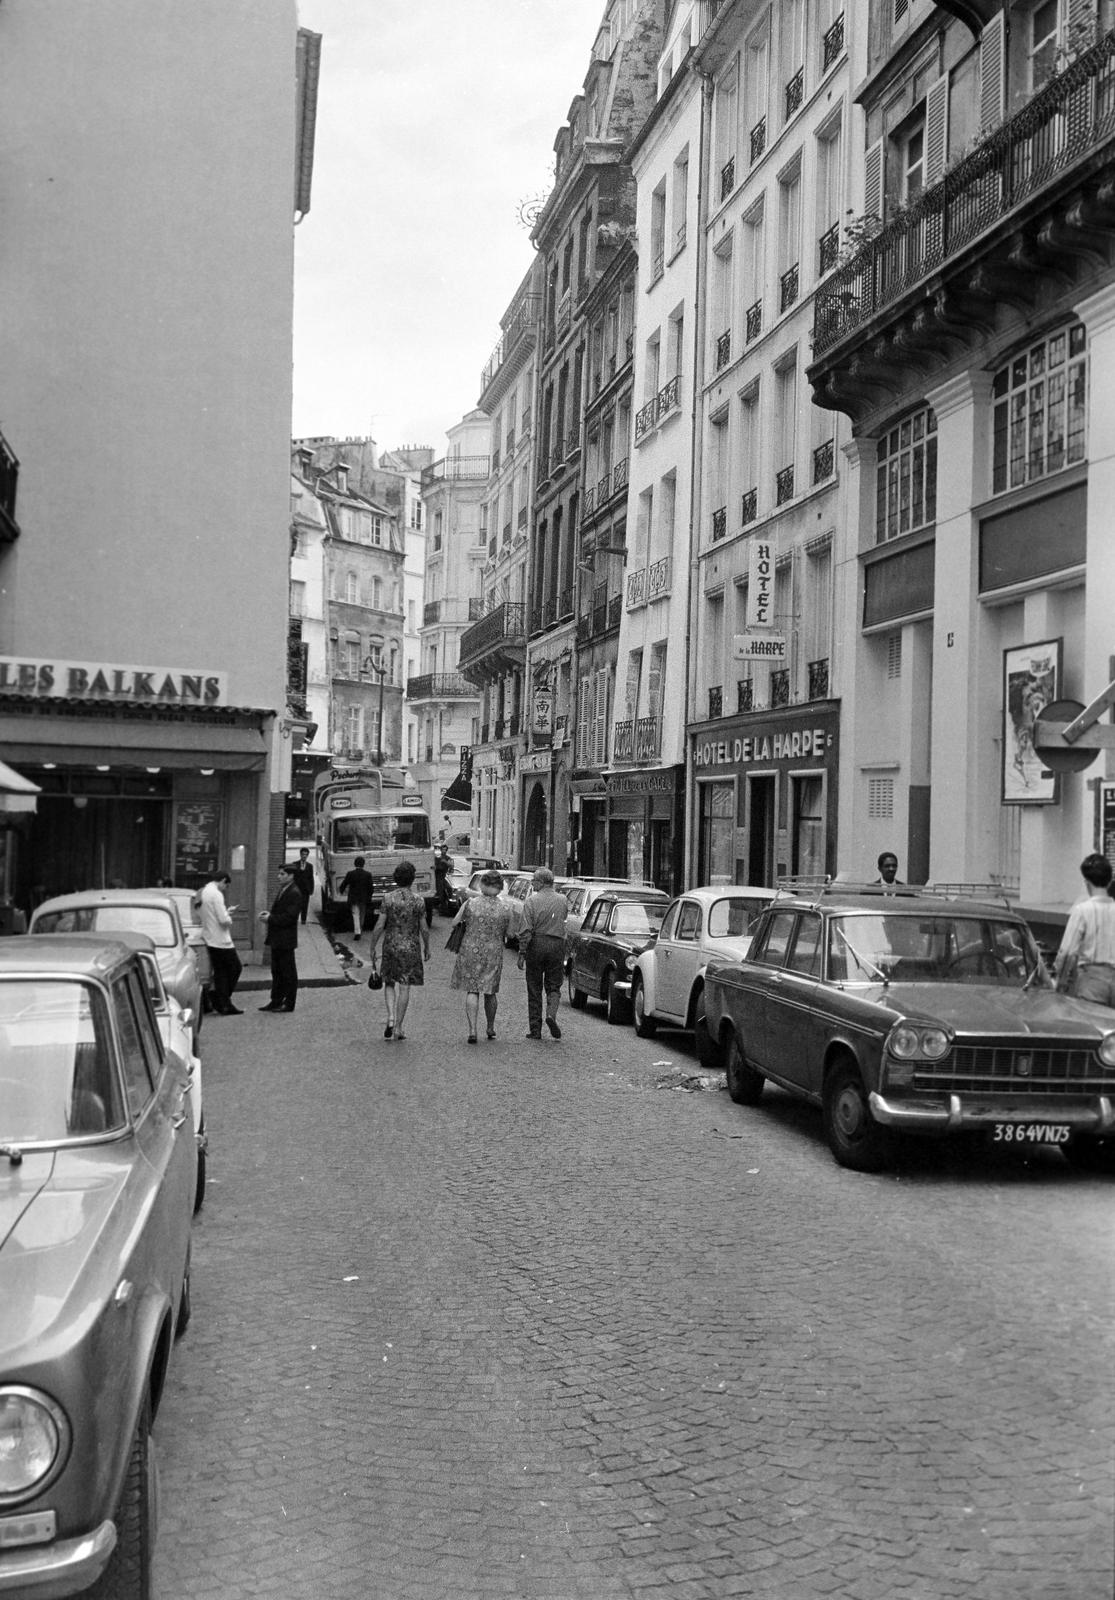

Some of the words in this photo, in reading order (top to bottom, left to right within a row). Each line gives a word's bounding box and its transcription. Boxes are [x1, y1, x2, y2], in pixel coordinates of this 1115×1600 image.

[756, 544, 771, 623] HOTEL
[750, 640, 785, 656] HARPE
[0, 662, 54, 689] LES
[68, 667, 221, 700] BALKANS
[535, 700, 550, 730] 南華
[696, 741, 733, 766] HOTEL
[734, 737, 752, 763] DE
[753, 736, 772, 761] LA
[773, 729, 825, 759] HARPE
